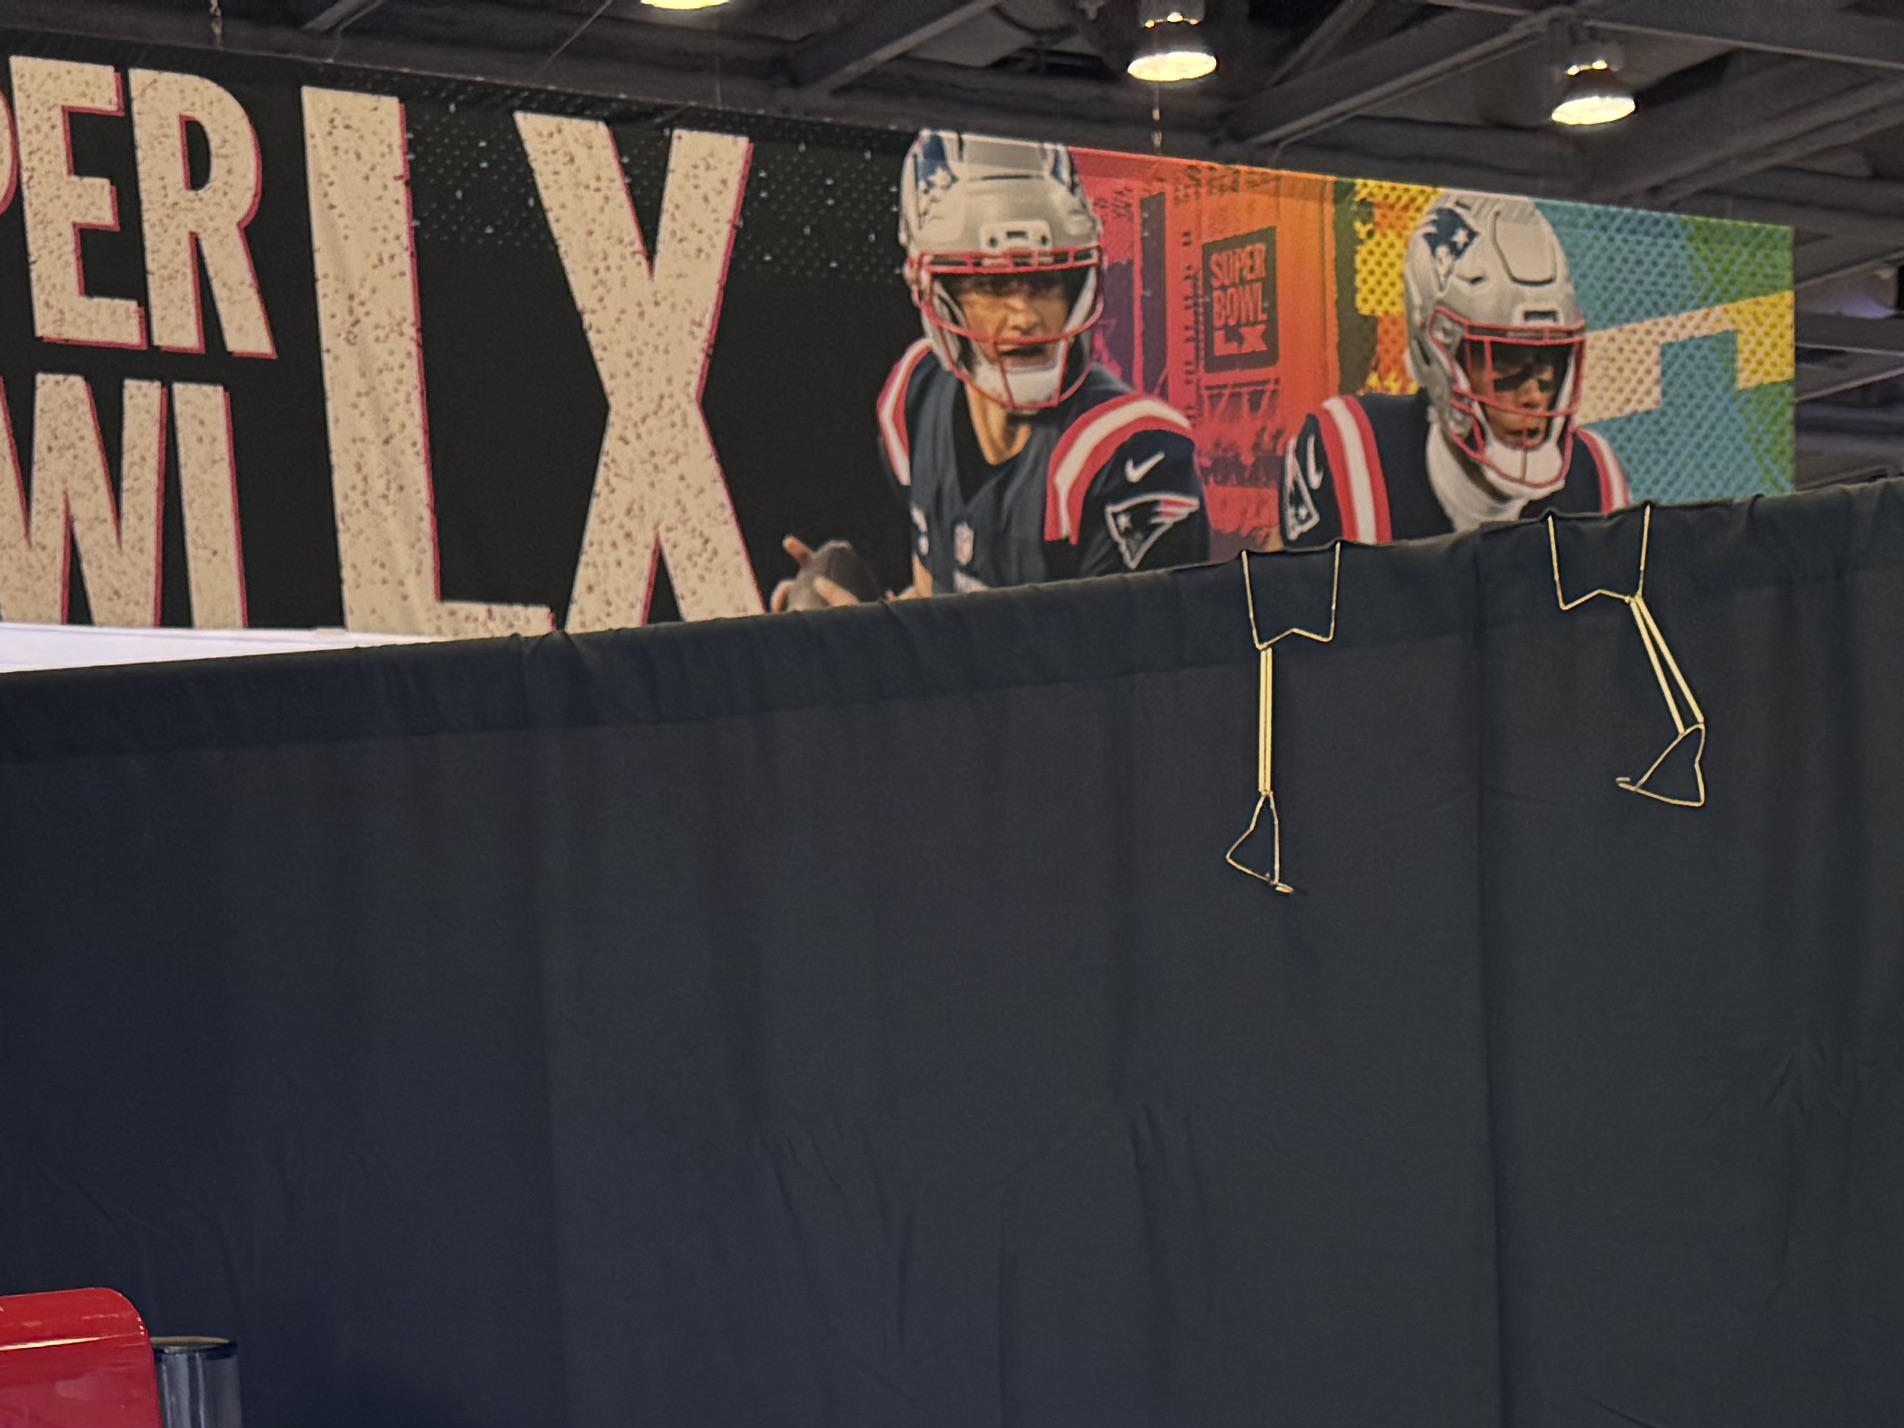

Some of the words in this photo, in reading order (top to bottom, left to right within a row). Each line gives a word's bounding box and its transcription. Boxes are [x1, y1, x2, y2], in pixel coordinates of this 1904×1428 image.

[1210, 243, 1267, 288] SUPER
[1213, 281, 1268, 327] BOWL
[302, 85, 771, 637] LX
[1214, 324, 1268, 357] LX
